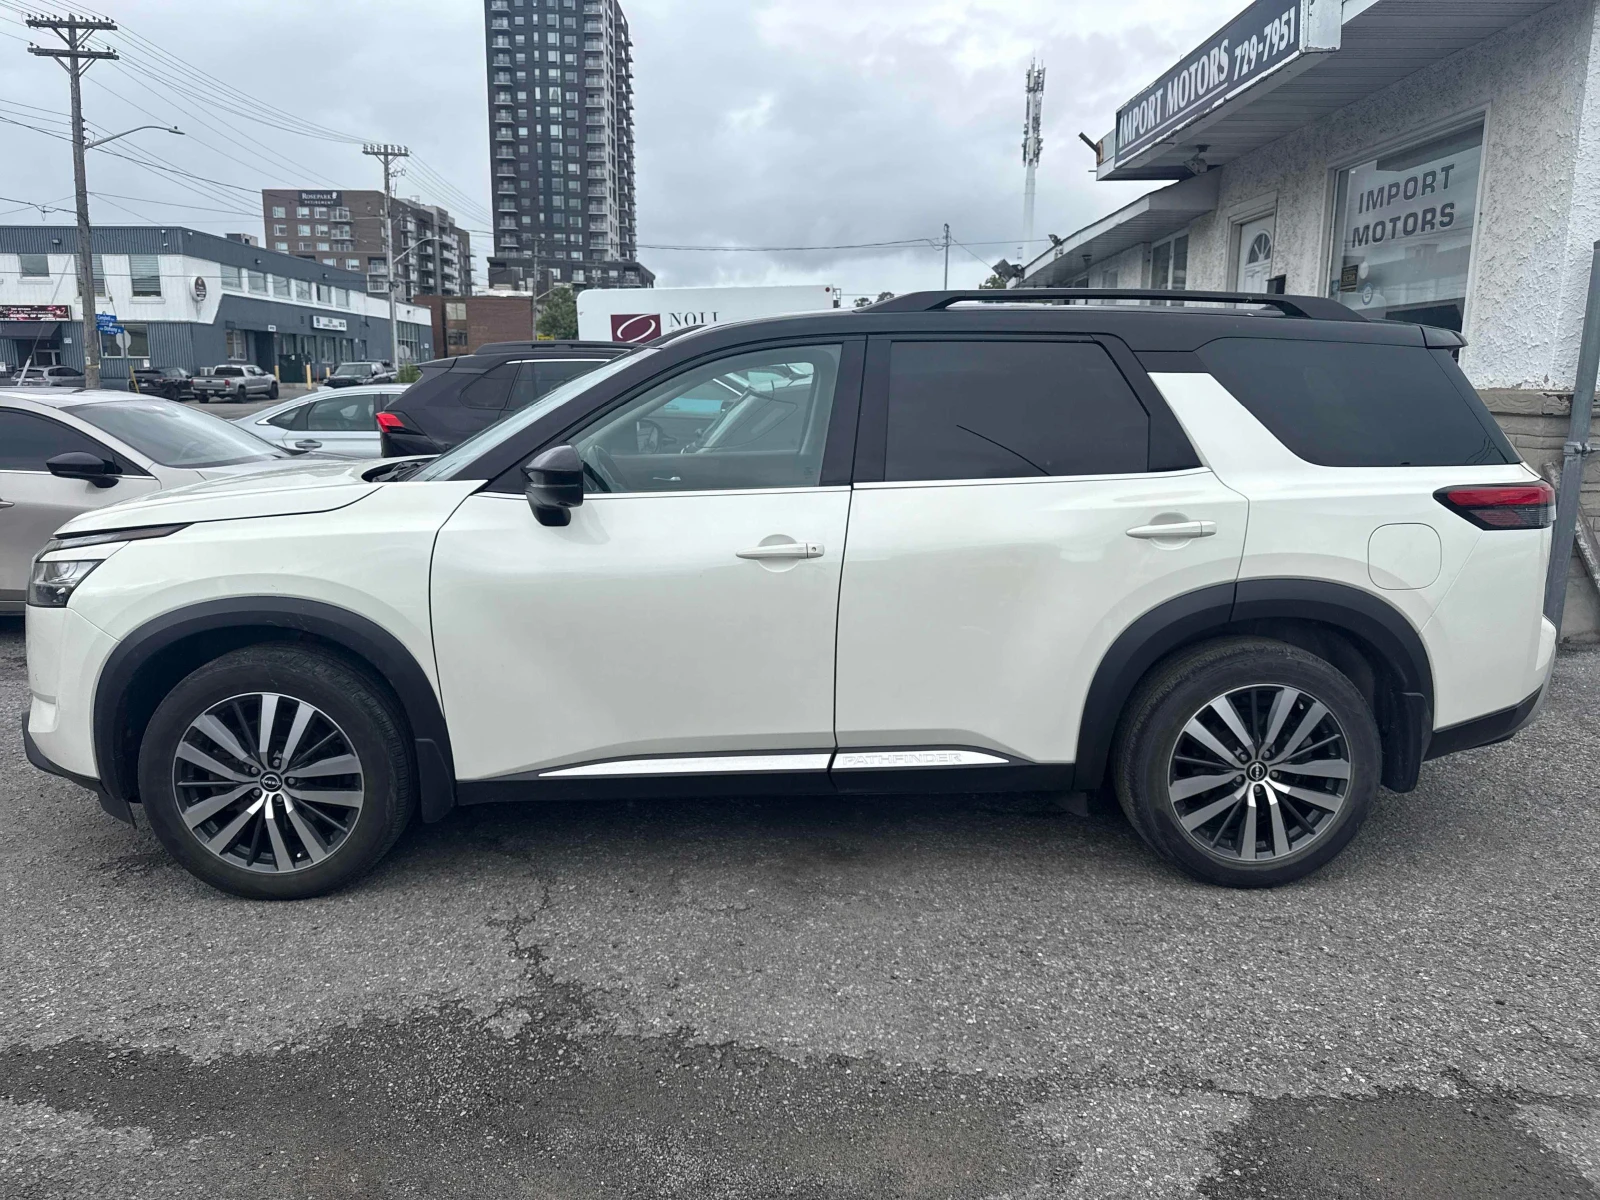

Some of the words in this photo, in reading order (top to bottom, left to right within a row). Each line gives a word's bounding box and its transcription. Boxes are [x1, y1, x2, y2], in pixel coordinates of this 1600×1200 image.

[1118, 88, 1164, 149] IMPORT
[1165, 38, 1229, 119] MOTORS
[1233, 6, 1296, 81] 729-7951
[1358, 163, 1455, 215] IMPORT
[1351, 202, 1455, 249] MOTORS
[842, 753, 962, 766] PATHFINDER
